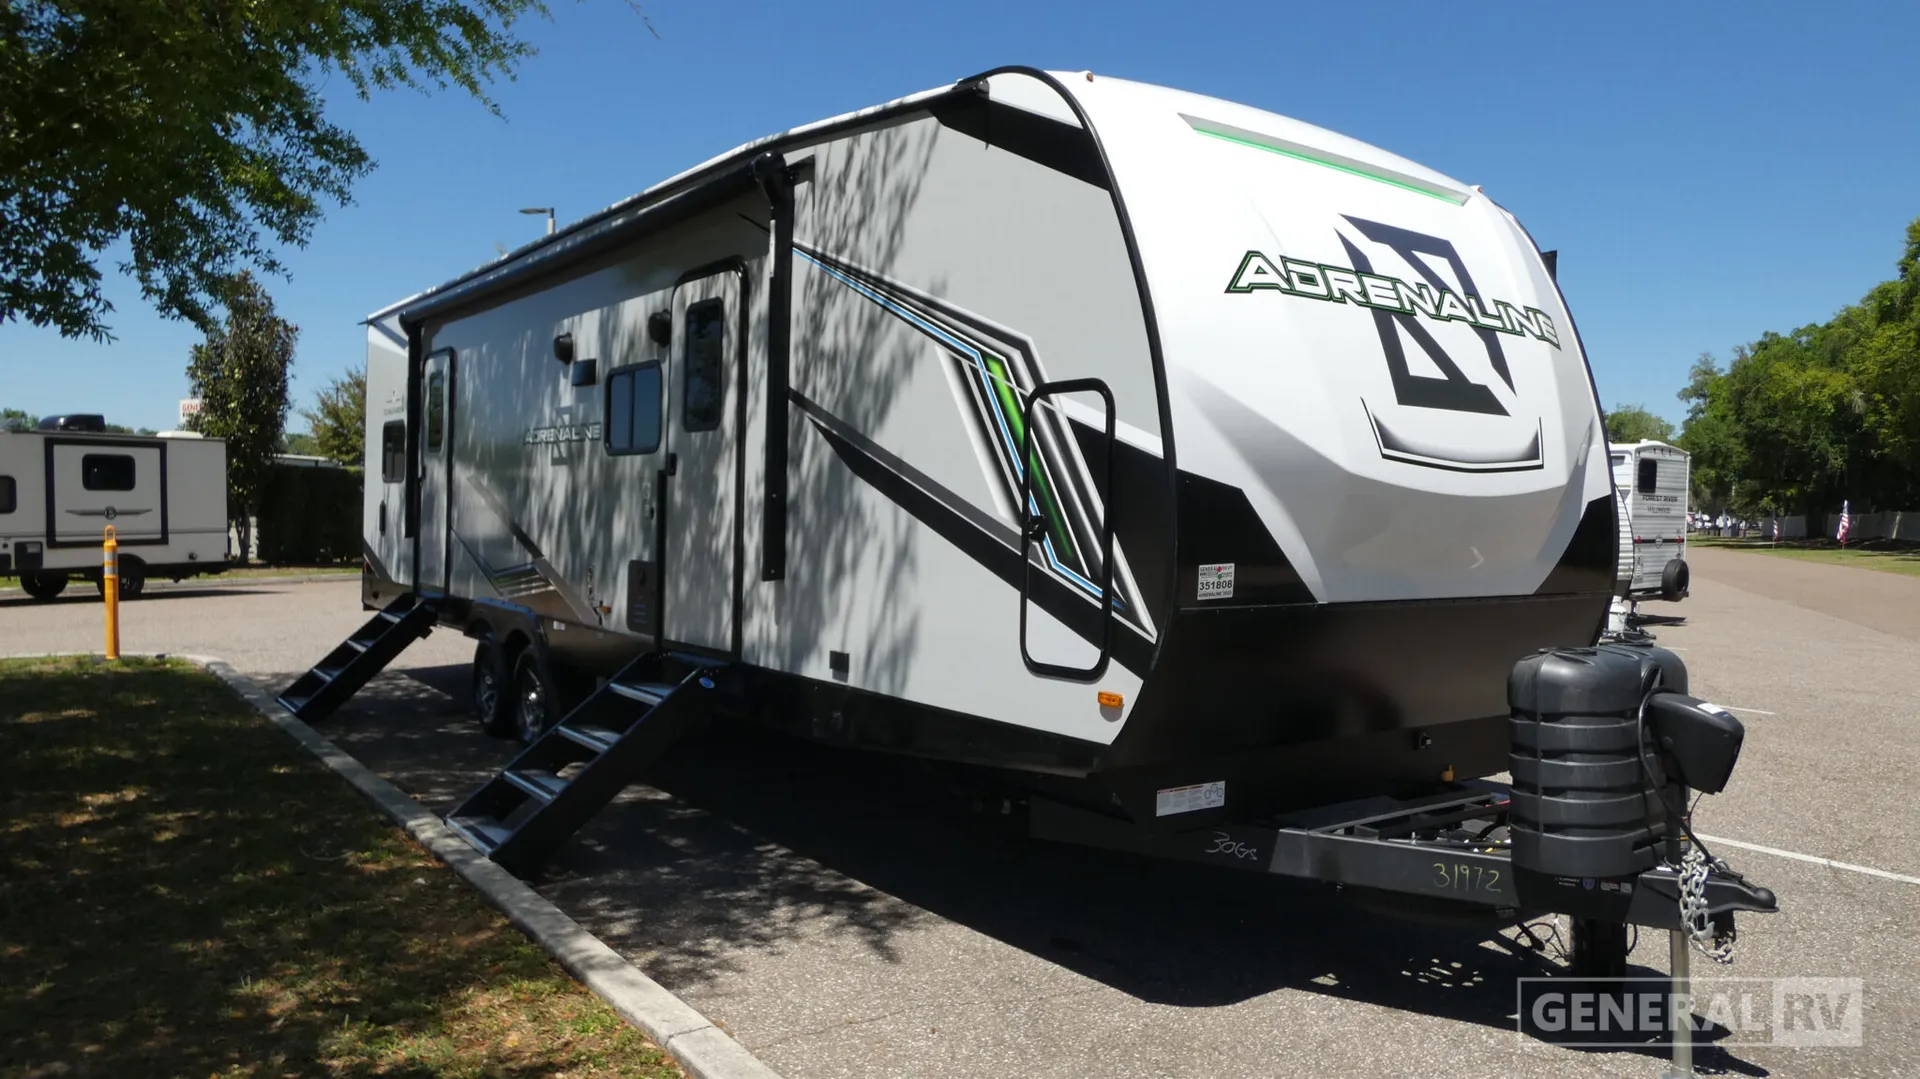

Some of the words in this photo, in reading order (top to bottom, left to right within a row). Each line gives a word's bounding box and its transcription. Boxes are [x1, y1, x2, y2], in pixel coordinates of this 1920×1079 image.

[1224, 250, 1562, 352] ADRENALINE
[523, 421, 602, 445] ADRENALINE
[1642, 494, 1663, 502] FOREST
[1199, 580, 1233, 591] 351808
[1432, 863, 1502, 893] 31972
